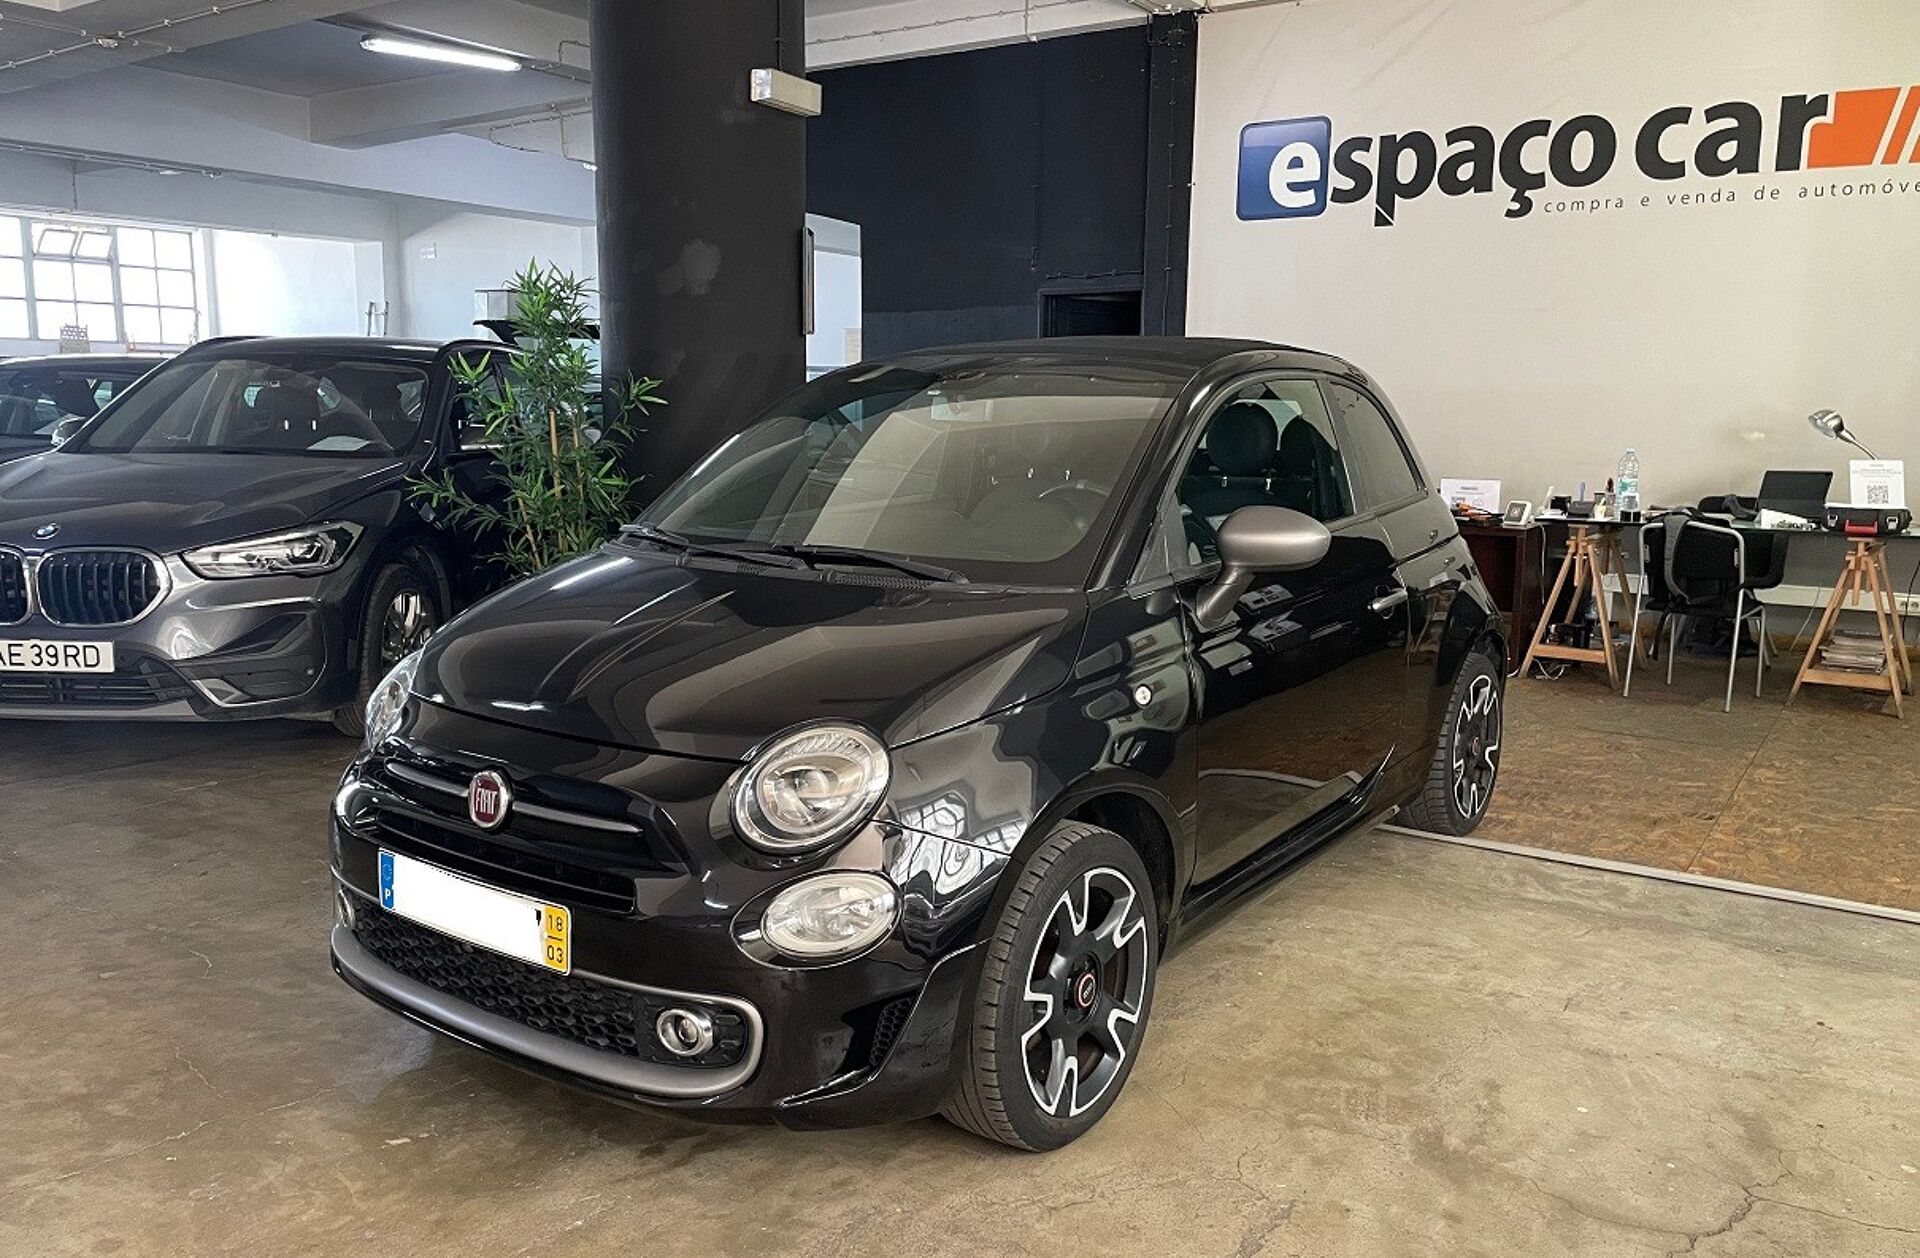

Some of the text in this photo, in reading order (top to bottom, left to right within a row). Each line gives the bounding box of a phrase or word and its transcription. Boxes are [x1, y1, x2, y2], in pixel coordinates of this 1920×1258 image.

[1268, 94, 1829, 227] espaço car
[1544, 197, 1624, 213] compra
[1640, 195, 1650, 207] e
[1667, 188, 1735, 205] venda
[1754, 185, 1780, 200] de
[30, 644, 59, 666] 39
[63, 645, 101, 667] RD
[476, 788, 498, 814] FIAT
[385, 888, 391, 900] P
[548, 915, 563, 932] 18
[547, 945, 563, 963] 03
